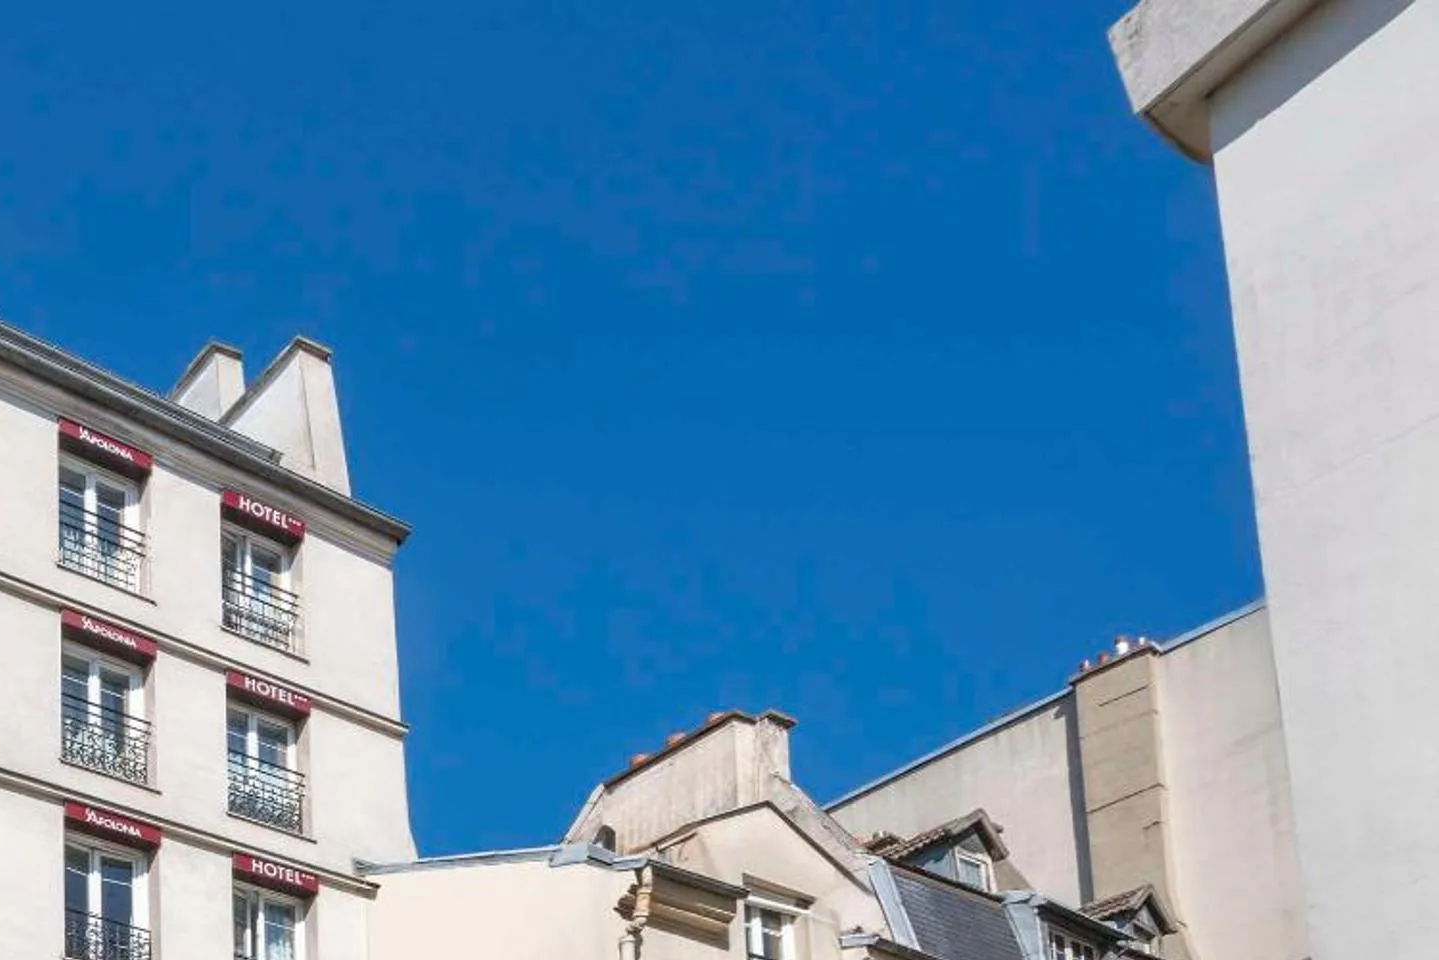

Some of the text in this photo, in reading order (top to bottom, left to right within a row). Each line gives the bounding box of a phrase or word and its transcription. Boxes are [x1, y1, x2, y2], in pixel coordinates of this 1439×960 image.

[239, 496, 288, 528] HOTEL
[244, 676, 295, 705] HOTEL
[252, 858, 303, 885] HOTEL
